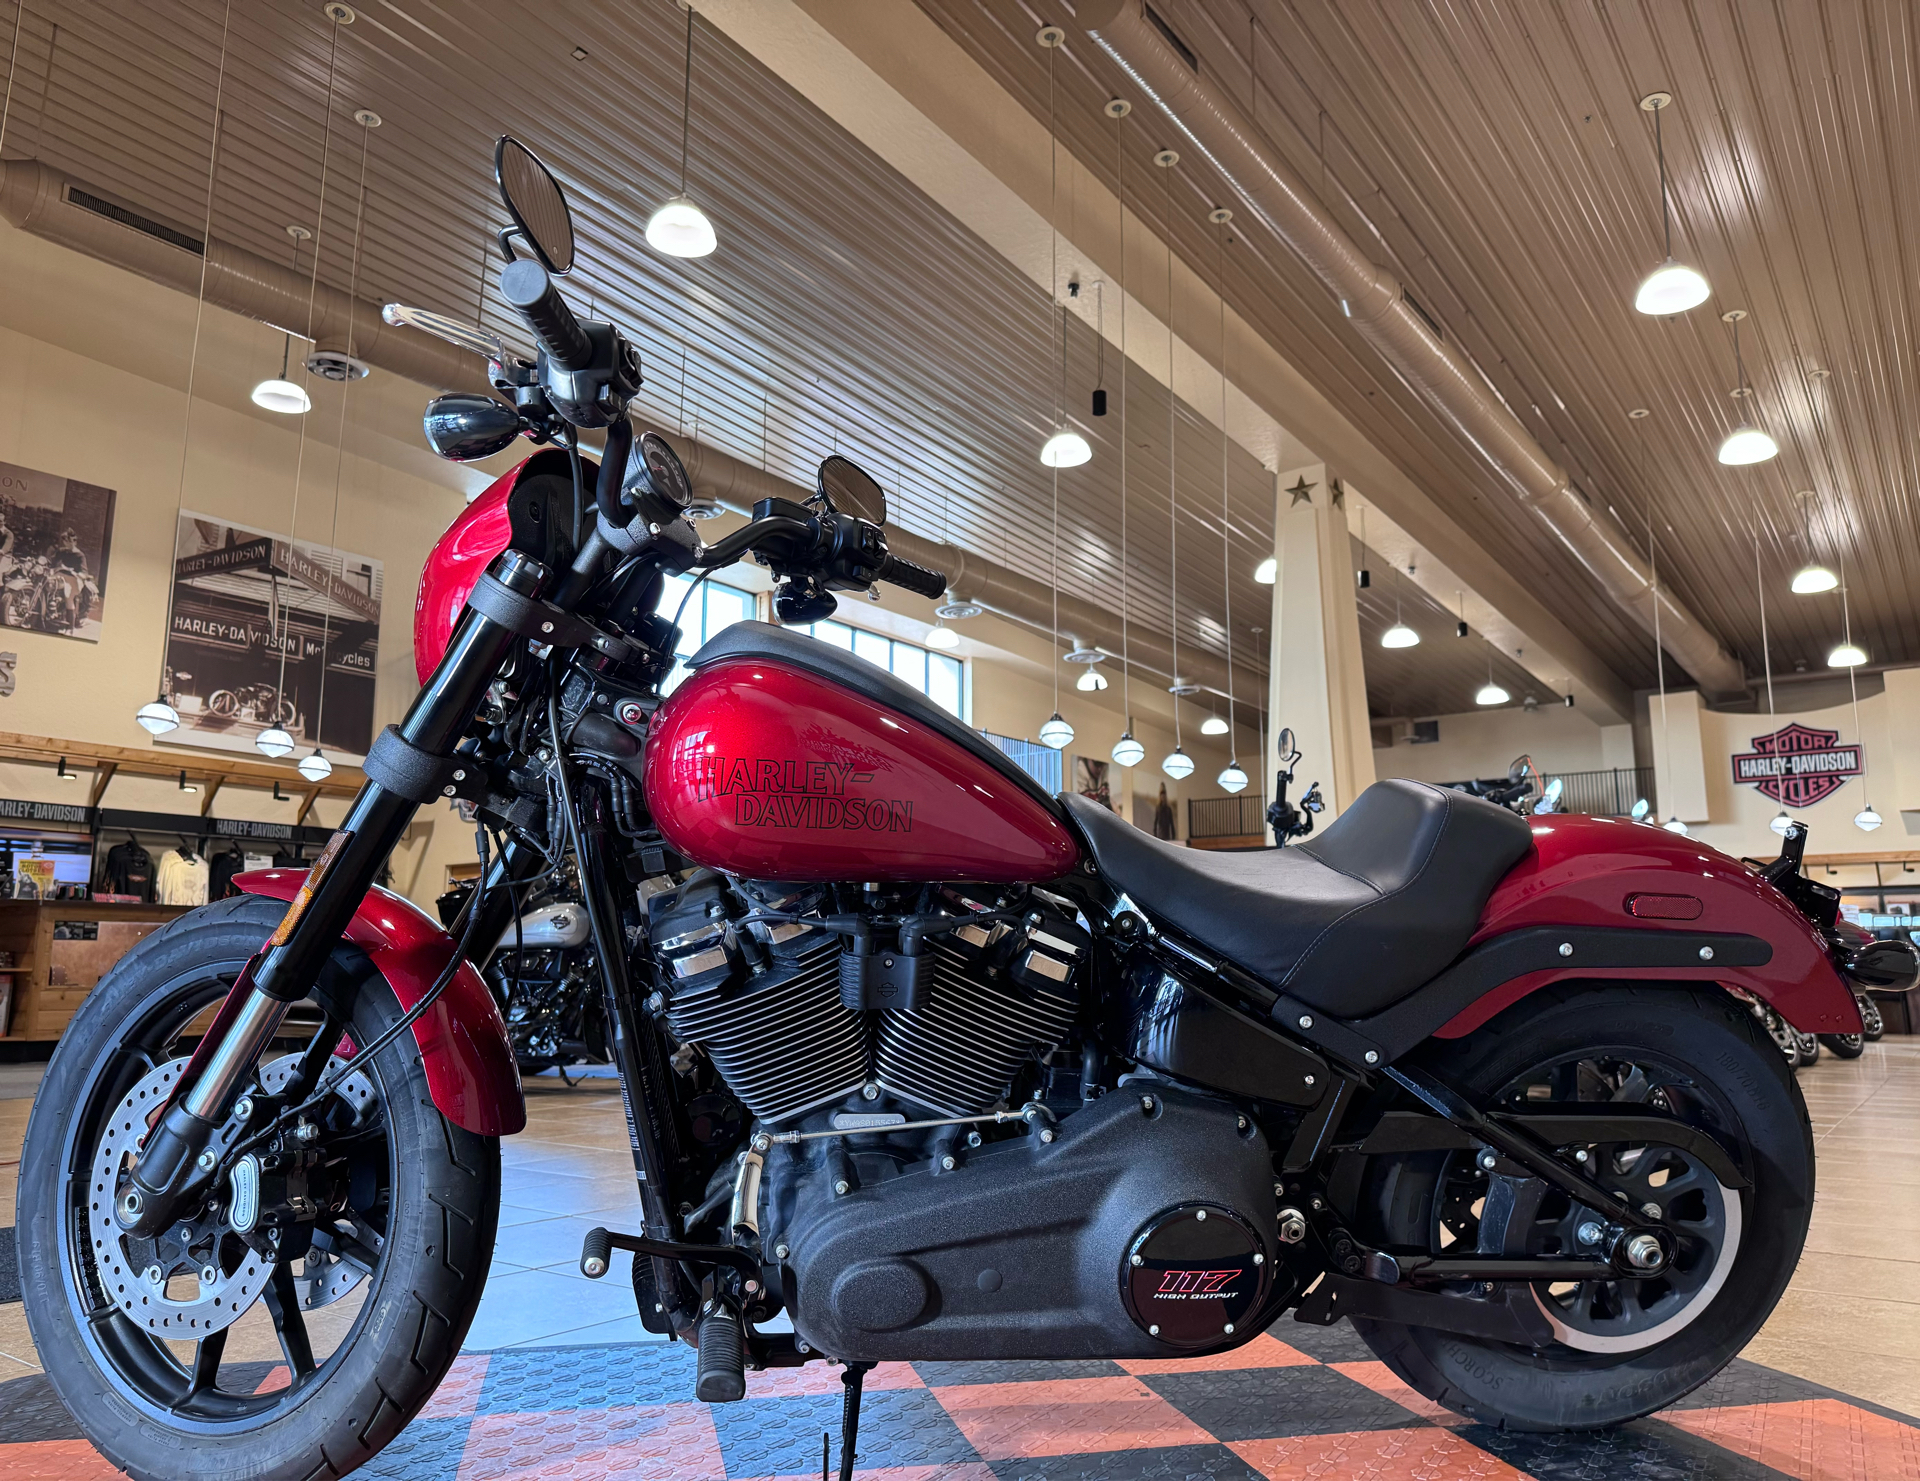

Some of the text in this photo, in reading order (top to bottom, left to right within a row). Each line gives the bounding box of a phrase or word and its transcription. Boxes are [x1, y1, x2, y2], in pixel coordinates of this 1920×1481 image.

[280, 548, 380, 617] HARLEY-DAVIDSON
[174, 615, 371, 668] HARLEY-DAVIDSON Morcycles
[1765, 731, 1826, 753] MOTOR
[1740, 751, 1857, 777] HARLEY-DAVIDSON
[1768, 777, 1830, 801] CYCLES
[735, 794, 914, 832] DAVIDSON
[216, 820, 293, 839] HARLEY-DAVIDSON
[1157, 1269, 1243, 1292] 117
[1189, 1292, 1239, 1300] OUTPUT
